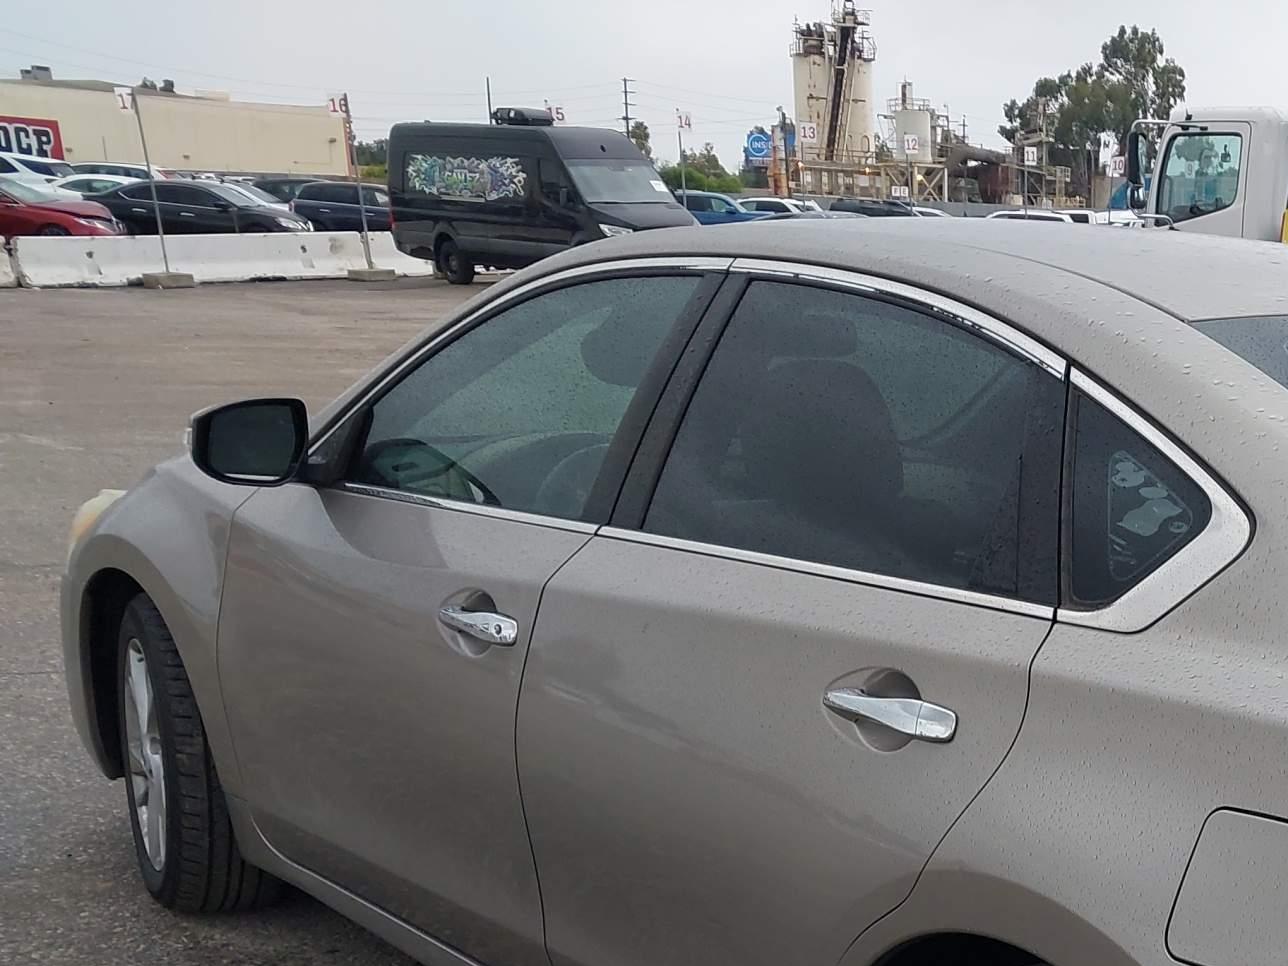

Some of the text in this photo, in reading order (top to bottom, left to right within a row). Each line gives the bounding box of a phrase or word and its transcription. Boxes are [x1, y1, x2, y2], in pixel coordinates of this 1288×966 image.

[329, 97, 349, 113] 16
[547, 106, 565, 121] 15
[678, 115, 691, 129] 14
[801, 126, 816, 139] 13
[906, 137, 918, 151] 12
[1025, 150, 1036, 163] 11
[1112, 159, 1124, 171] 10
